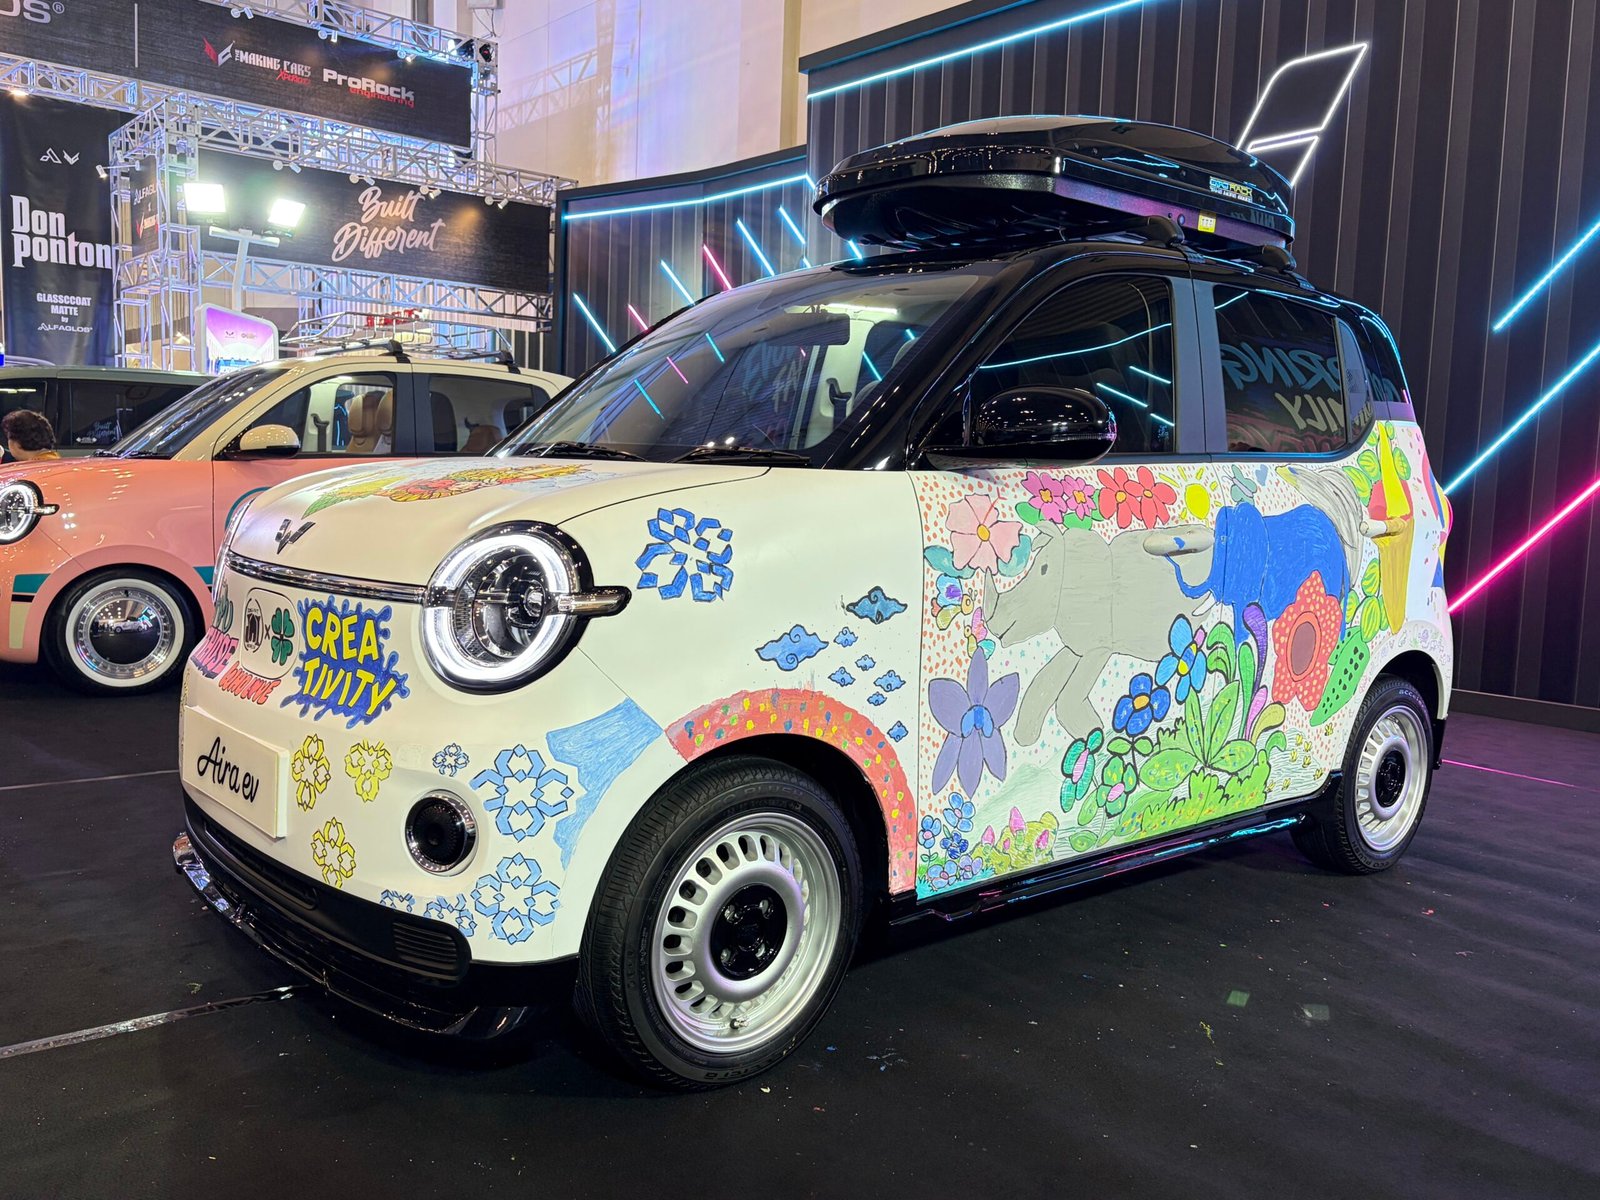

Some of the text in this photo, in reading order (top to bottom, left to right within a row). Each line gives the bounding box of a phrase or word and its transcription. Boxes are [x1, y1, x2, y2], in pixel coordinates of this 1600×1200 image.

[239, 50, 281, 70] MAKING
[283, 60, 312, 78] CARS
[322, 68, 415, 101] ProRock
[349, 86, 415, 108] engineering
[10, 194, 66, 238] Don
[358, 186, 426, 224] Built
[331, 218, 446, 262] Different
[51, 305, 79, 316] MATTE
[306, 607, 379, 664] CREA
[303, 657, 397, 715] TIVITY
[241, 773, 260, 803] ev
